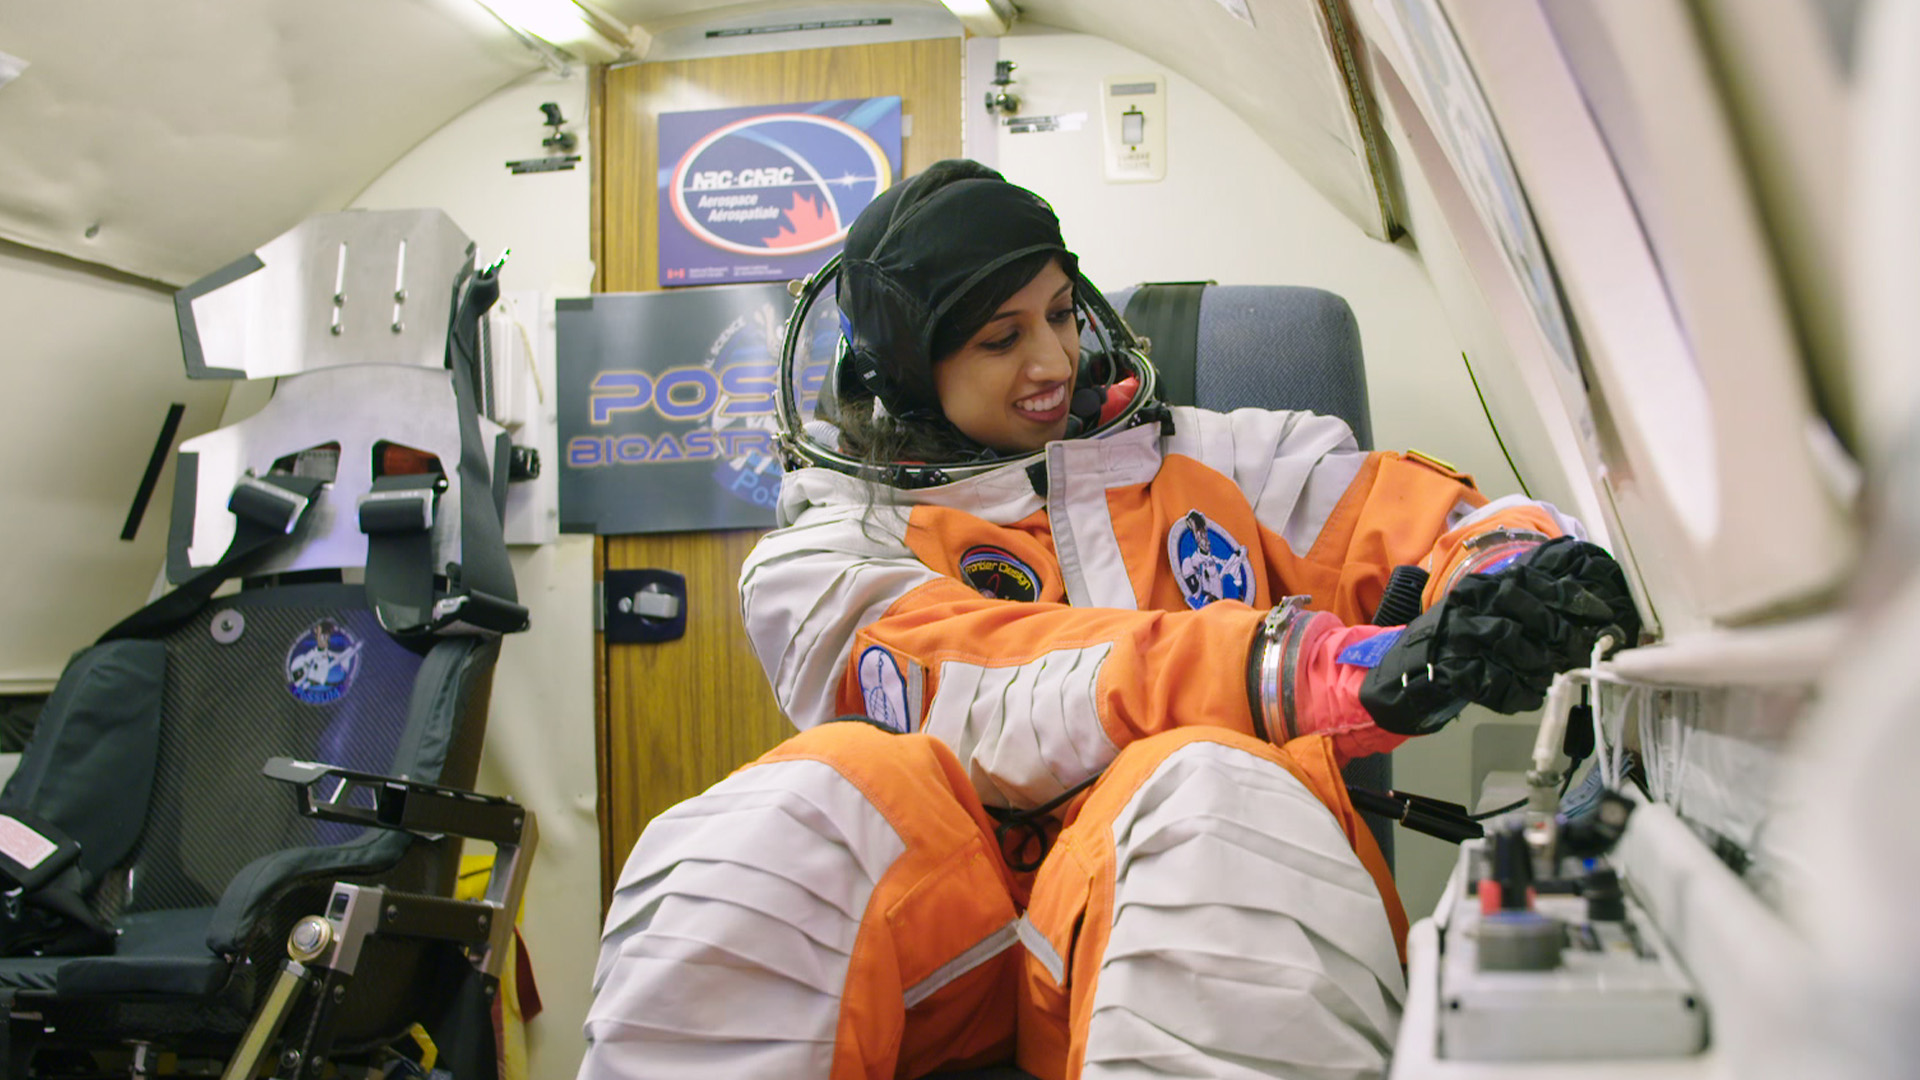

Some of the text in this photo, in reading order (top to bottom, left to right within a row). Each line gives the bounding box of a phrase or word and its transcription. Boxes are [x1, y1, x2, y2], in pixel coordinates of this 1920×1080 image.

[698, 195, 759, 209] Aerospace
[707, 206, 780, 224] Aérospatiale
[998, 563, 1032, 591] Design
